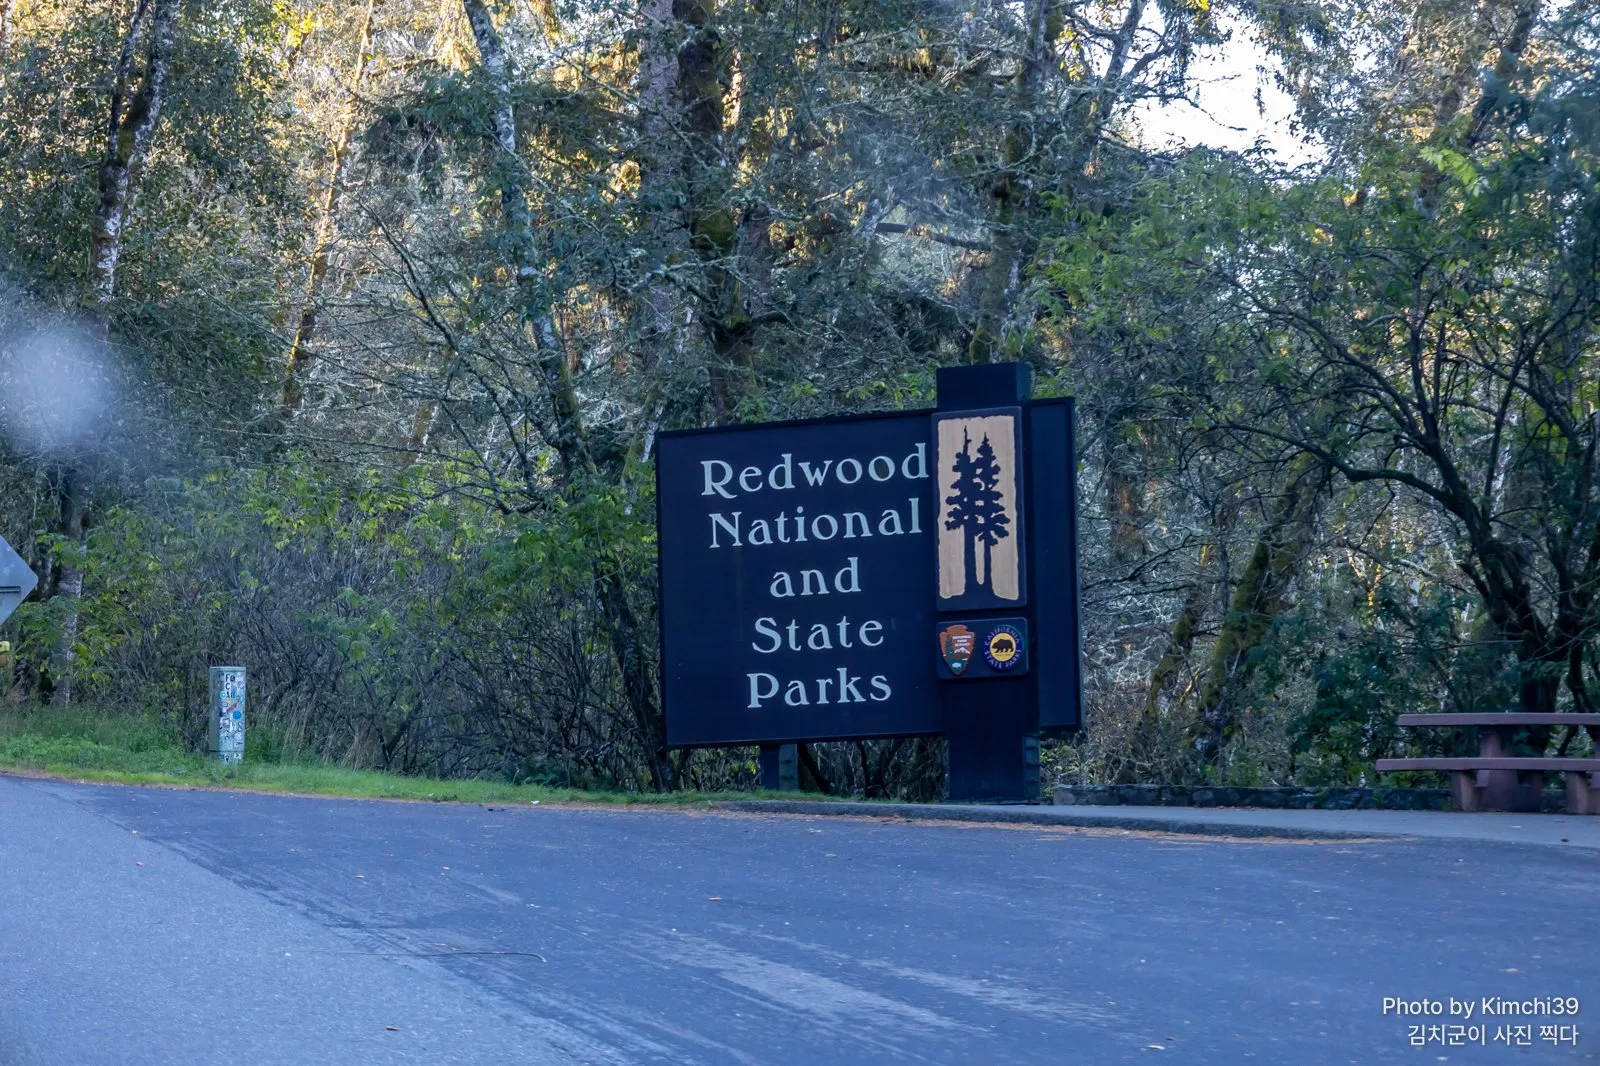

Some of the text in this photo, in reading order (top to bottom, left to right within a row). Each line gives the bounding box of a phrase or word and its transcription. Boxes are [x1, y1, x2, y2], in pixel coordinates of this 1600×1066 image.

[700, 442, 930, 499] Redwood
[708, 497, 923, 549] National
[769, 556, 862, 598] and
[751, 615, 884, 654] State
[746, 667, 892, 709] Parks
